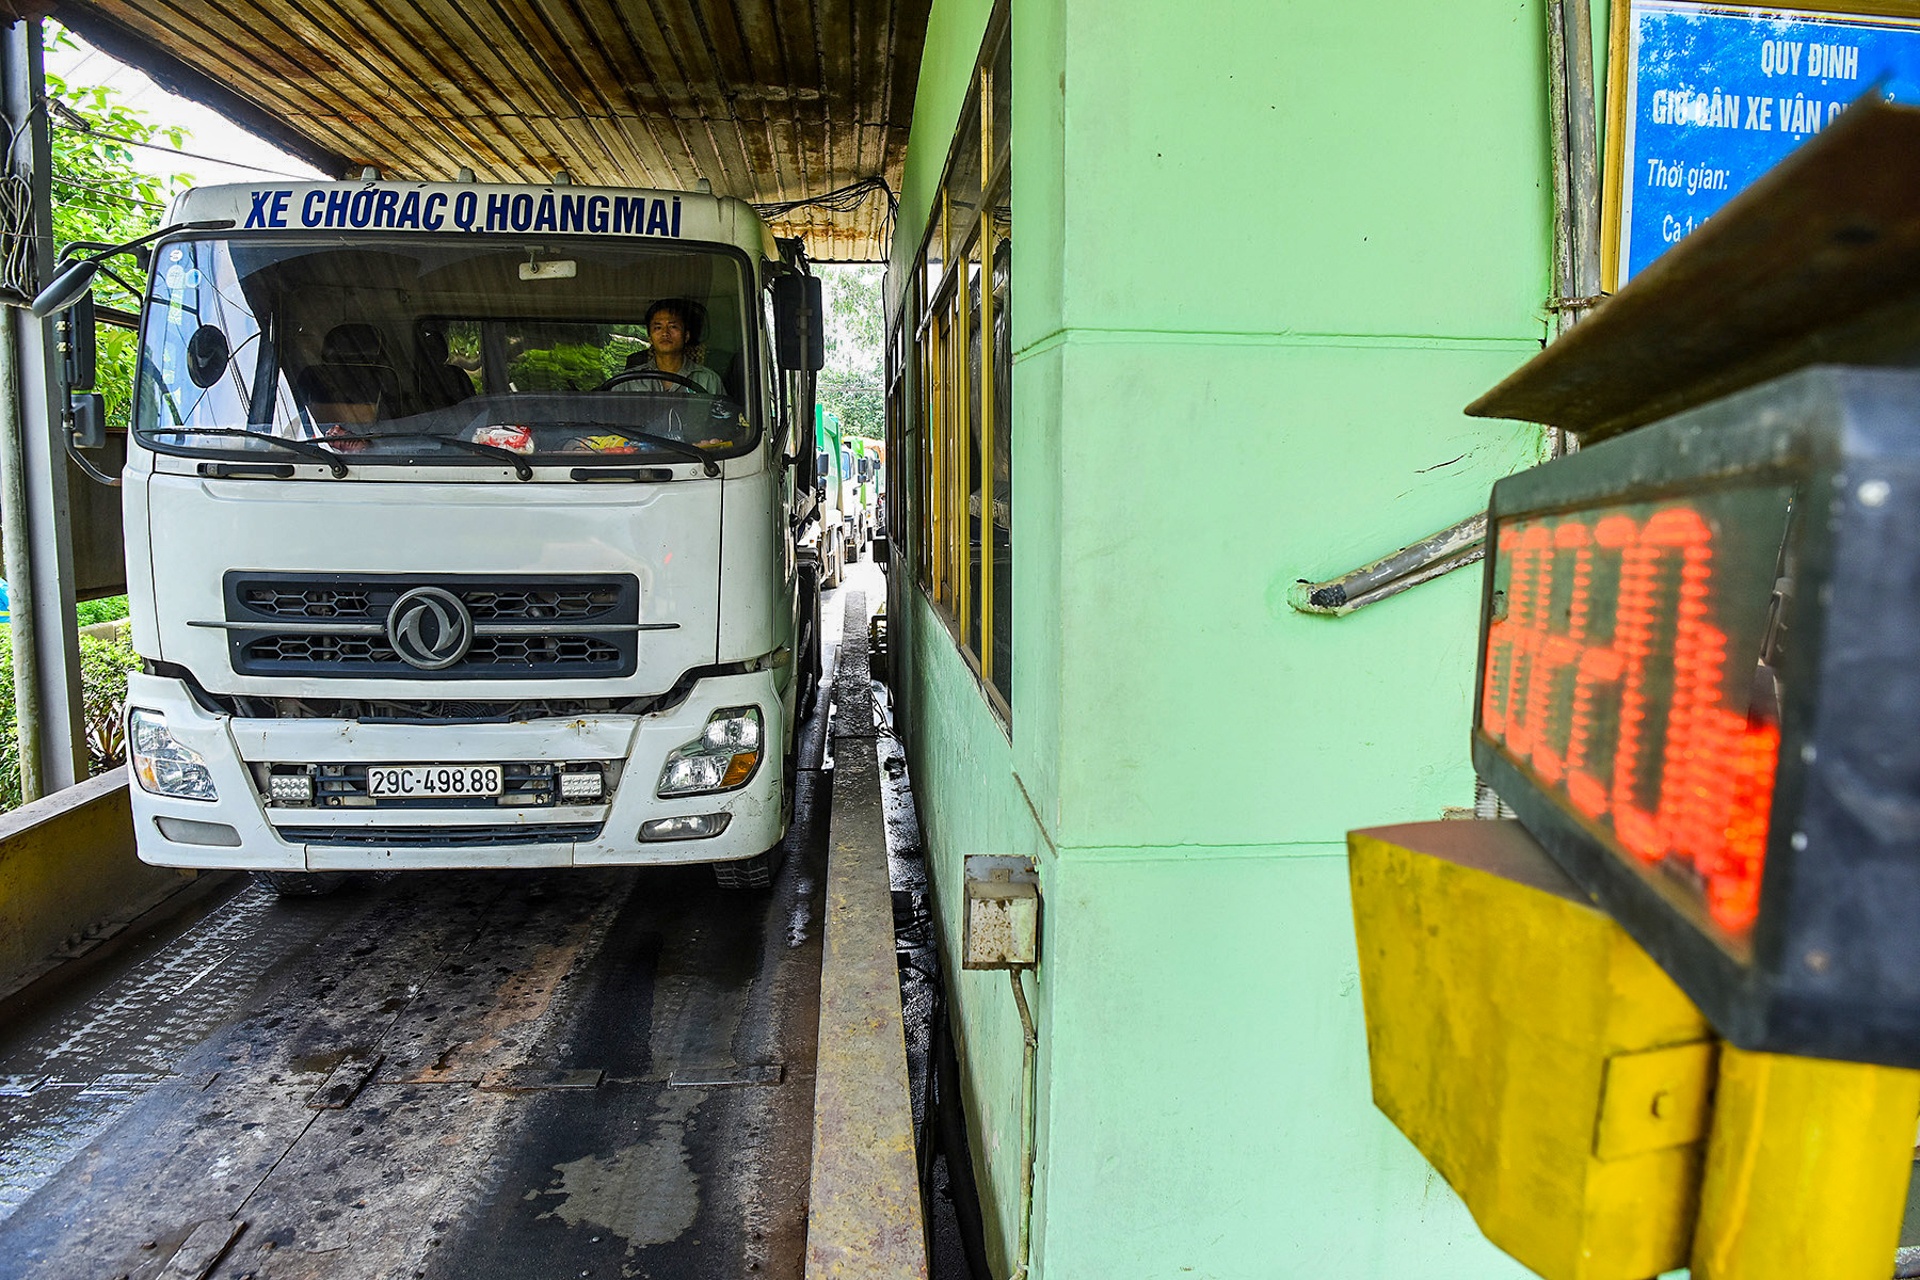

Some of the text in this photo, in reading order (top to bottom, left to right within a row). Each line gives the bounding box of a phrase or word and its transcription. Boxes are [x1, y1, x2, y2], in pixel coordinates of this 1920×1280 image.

[1761, 40, 1859, 85] QUY ĐỊNH
[1744, 96, 1774, 131] XE
[1779, 93, 1822, 140] VẬN
[1647, 159, 1731, 195] Thời gian:
[244, 190, 293, 229] XE
[372, 769, 498, 794] 29C-498.88
